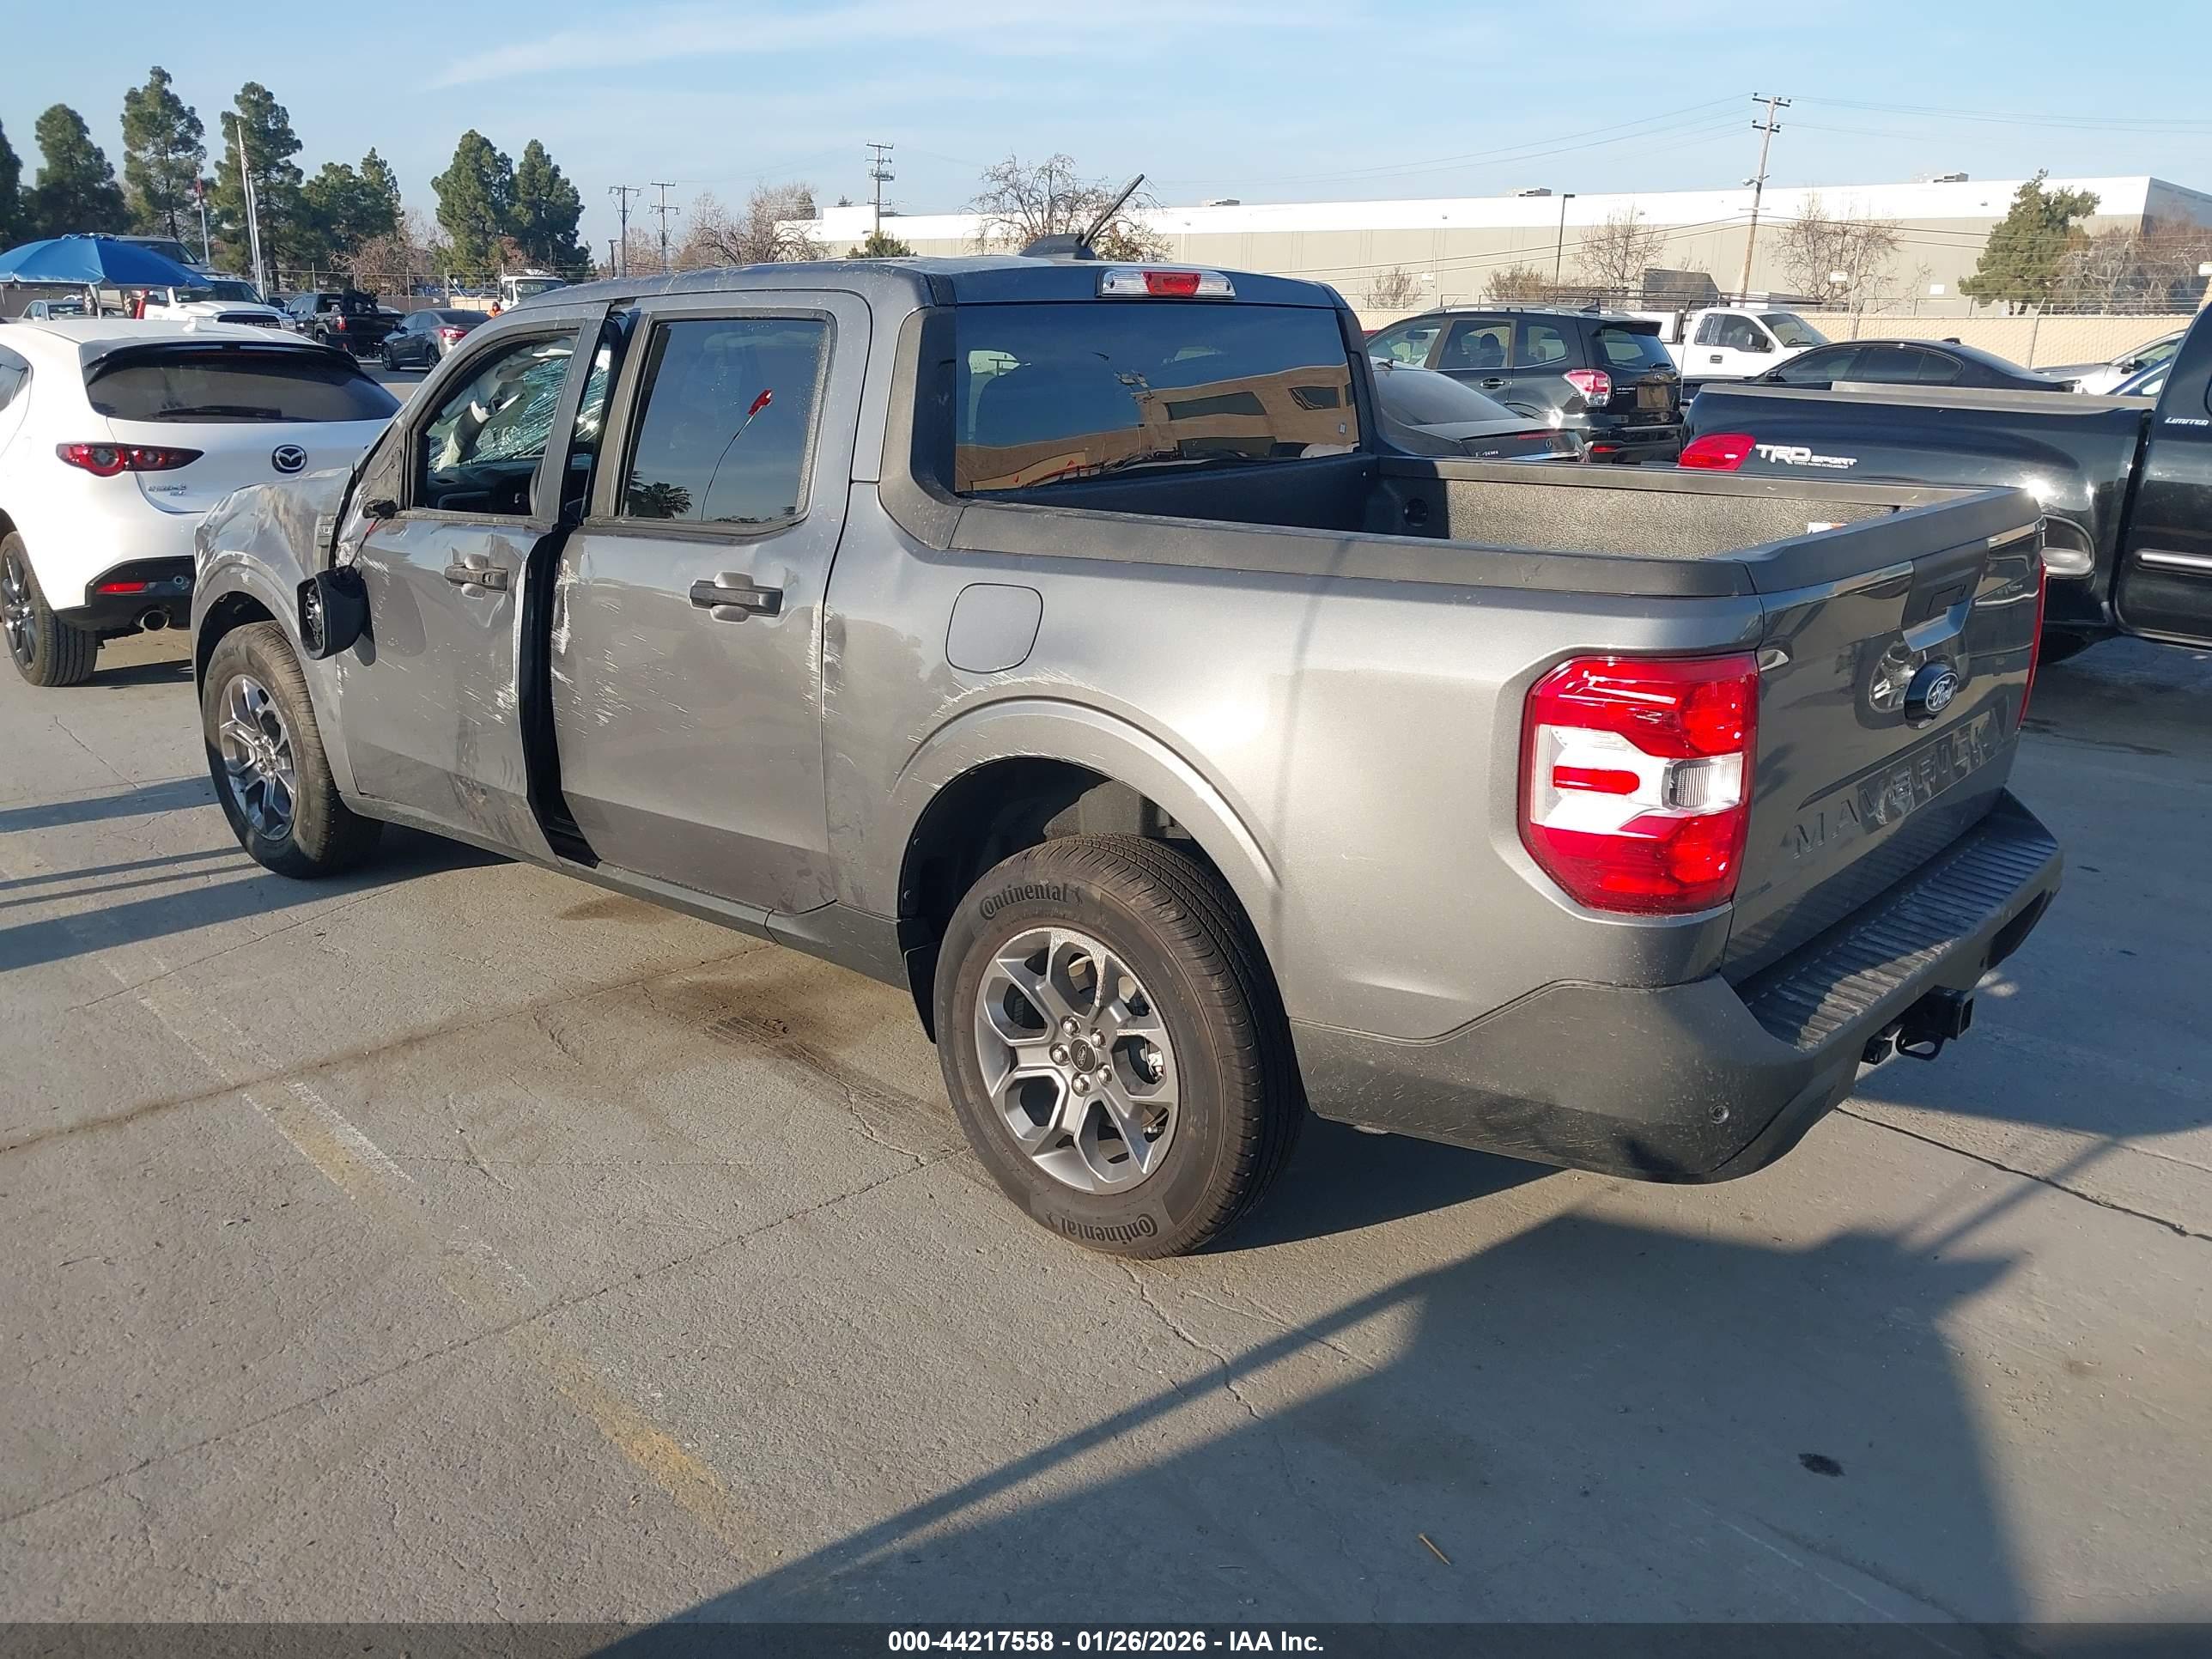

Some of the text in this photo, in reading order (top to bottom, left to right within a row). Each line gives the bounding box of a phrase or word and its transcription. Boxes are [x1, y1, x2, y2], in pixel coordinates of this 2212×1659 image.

[1755, 443, 1812, 465] TRD
[1811, 455, 1857, 465] SPORT
[1929, 677, 1957, 708] Ford
[979, 882, 1068, 921] Continental
[1060, 1212, 1158, 1244] Continental
